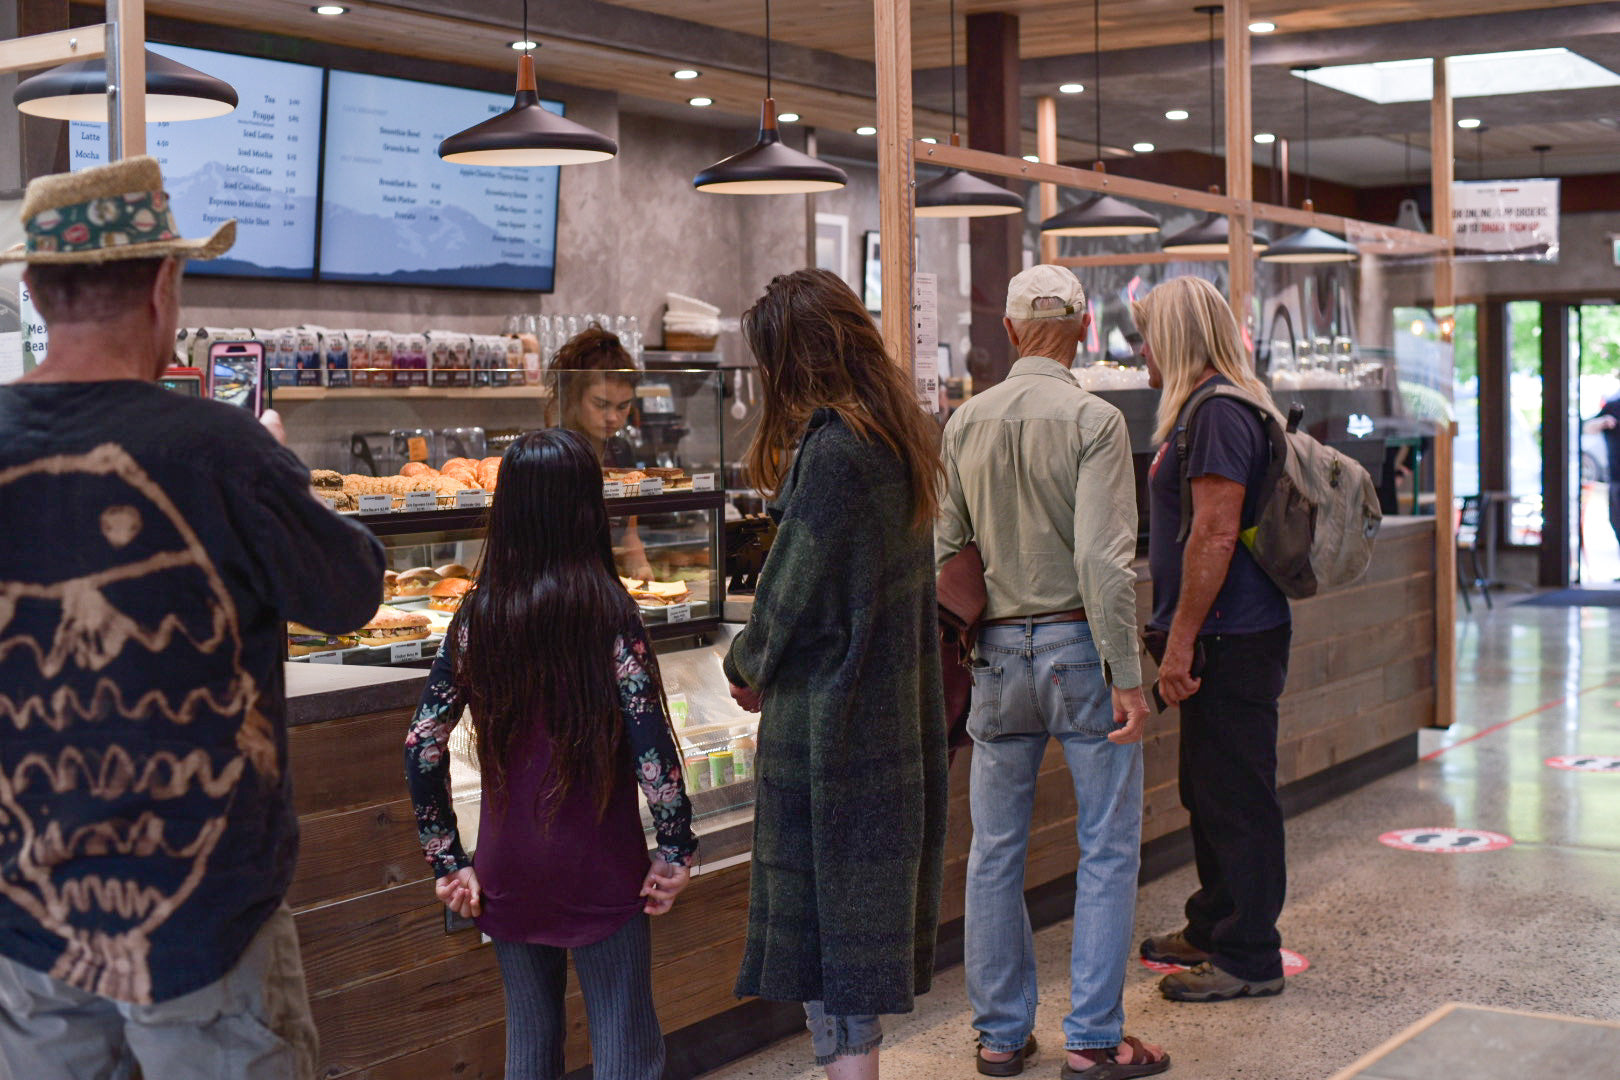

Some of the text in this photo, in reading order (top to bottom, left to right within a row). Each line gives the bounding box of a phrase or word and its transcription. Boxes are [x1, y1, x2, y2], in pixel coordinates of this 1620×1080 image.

[264, 95, 275, 104] Tea
[81, 131, 100, 141] Latte
[257, 130, 274, 140] Latte
[75, 149, 99, 159] Mocha
